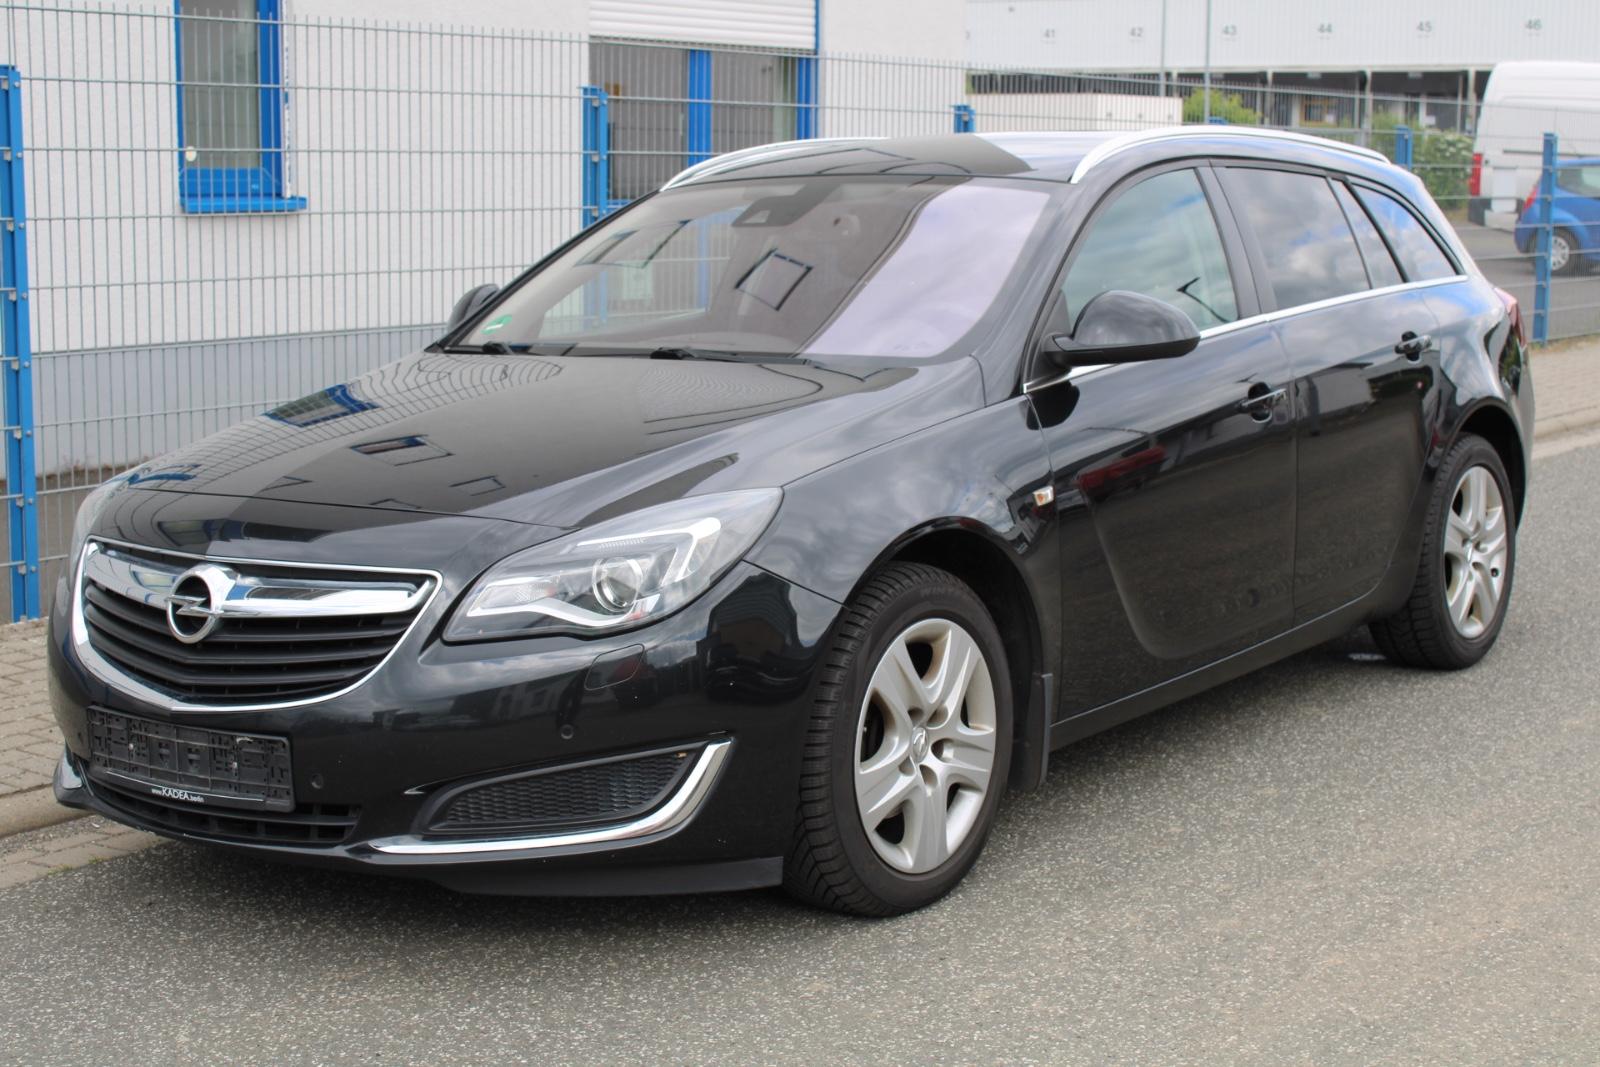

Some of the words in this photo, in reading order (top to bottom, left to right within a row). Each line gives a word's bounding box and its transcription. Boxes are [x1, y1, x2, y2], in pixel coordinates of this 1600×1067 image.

[1221, 24, 1238, 36] 43
[1317, 23, 1333, 34] 44
[1416, 20, 1433, 32] 45
[1525, 18, 1543, 31] 46
[1043, 28, 1056, 39] 41
[1130, 26, 1144, 38] 42
